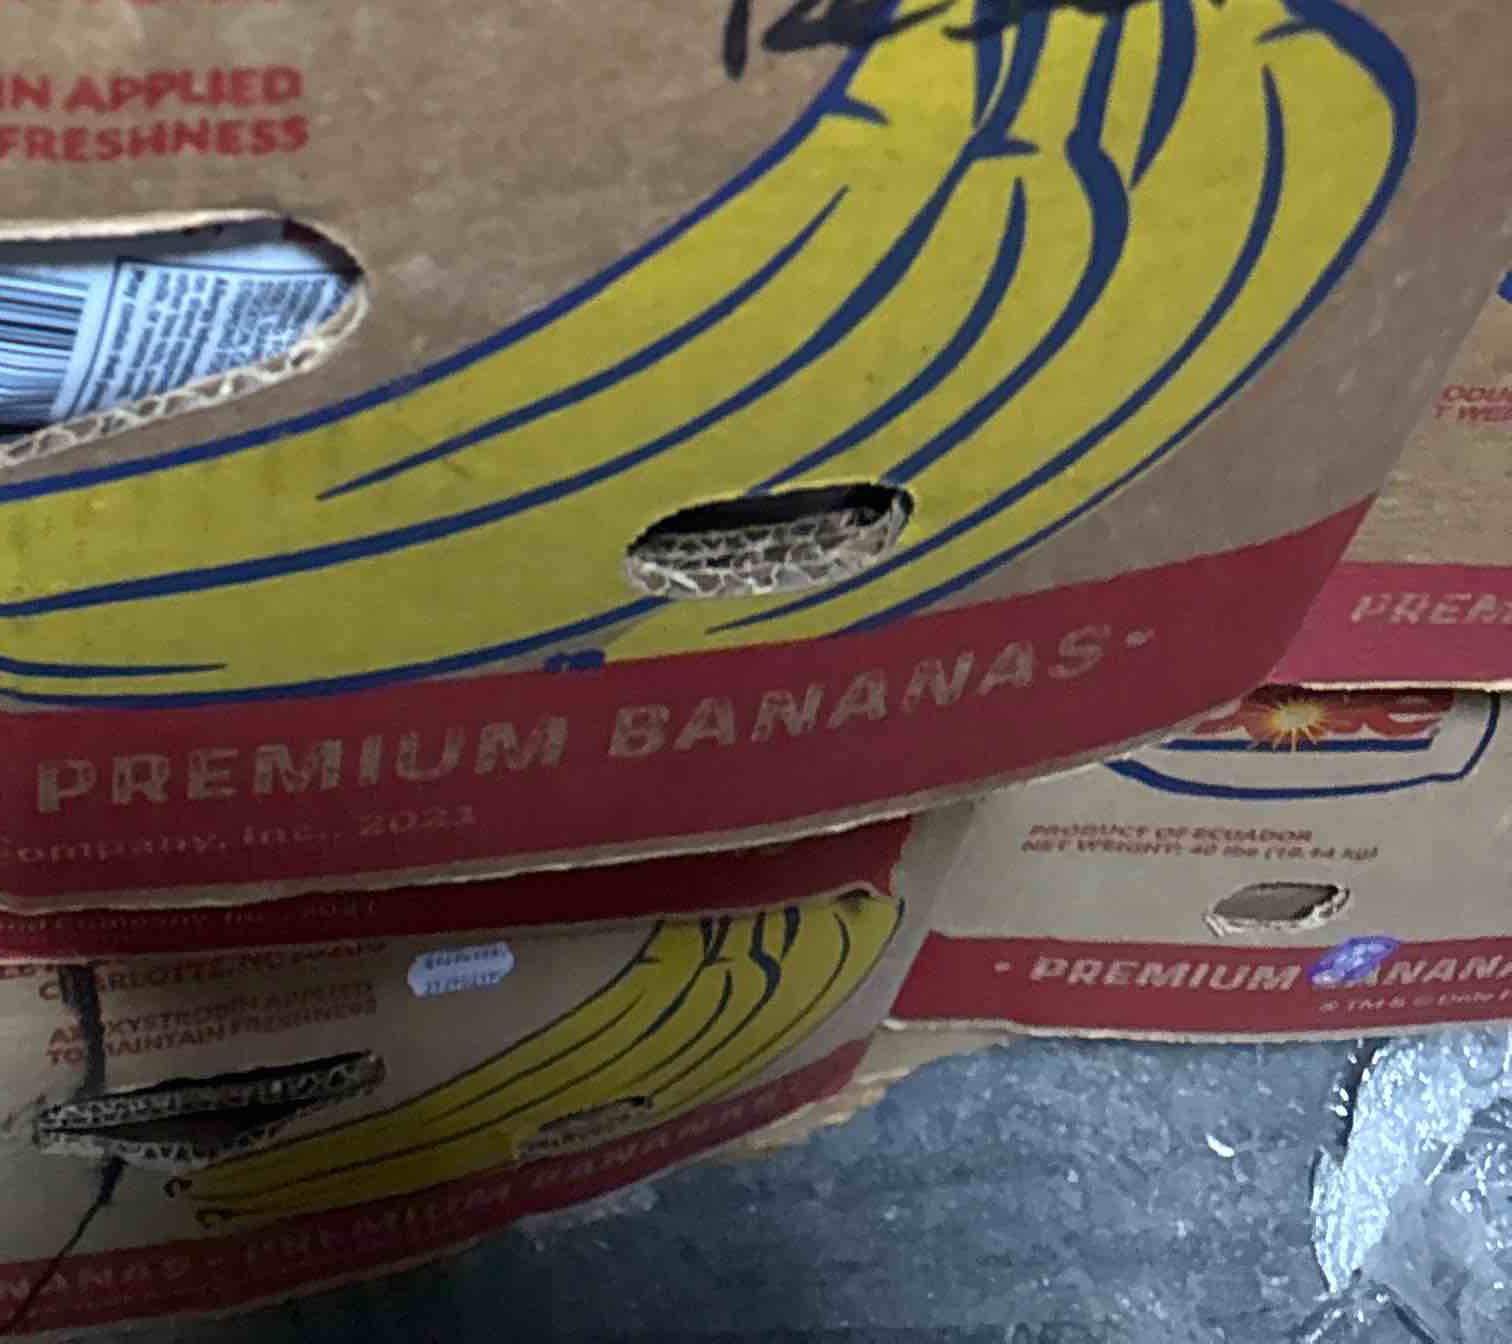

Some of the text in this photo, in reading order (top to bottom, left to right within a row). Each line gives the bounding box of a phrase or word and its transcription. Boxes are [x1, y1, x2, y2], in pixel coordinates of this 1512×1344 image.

[62, 65, 303, 115] APPLIED
[35, 716, 569, 813] PREMIUM
[607, 623, 1114, 760] BANANAS
[1030, 956, 1303, 992] PREMIUM
